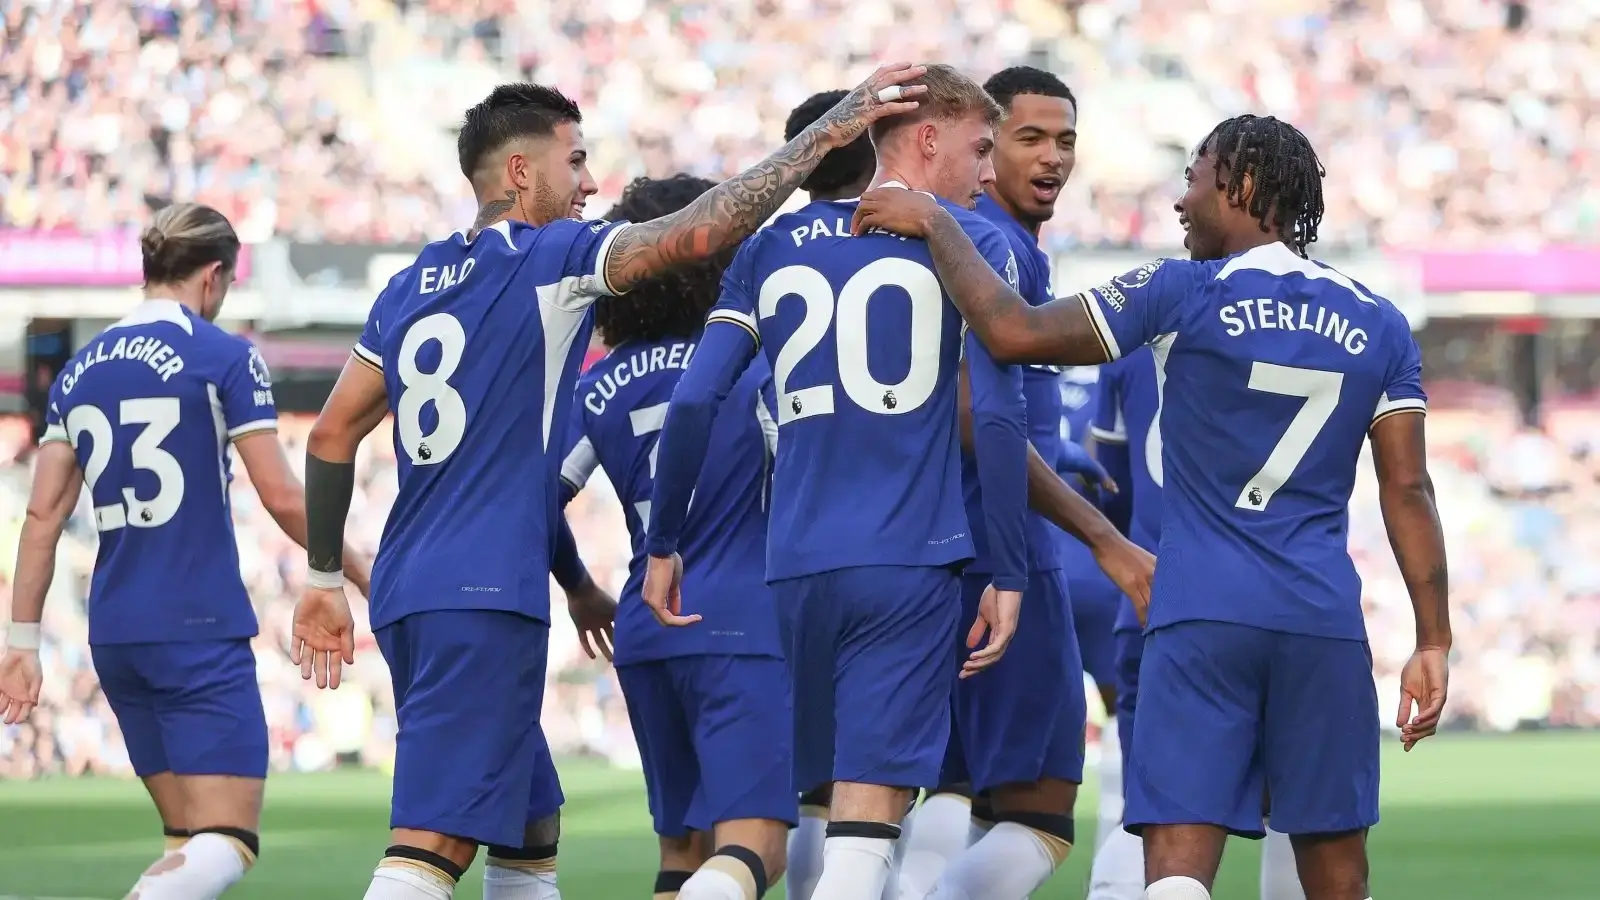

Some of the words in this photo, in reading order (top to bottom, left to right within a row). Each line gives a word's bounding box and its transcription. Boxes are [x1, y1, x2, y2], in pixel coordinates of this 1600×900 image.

[790, 217, 908, 248] PAL
[61, 336, 184, 395] GALLAGHER
[759, 257, 943, 426] 20
[1219, 298, 1368, 355] STERLING
[397, 312, 467, 466] 8
[585, 343, 695, 416] CUCUREL
[66, 397, 185, 532] 23
[1235, 361, 1344, 512] 7
